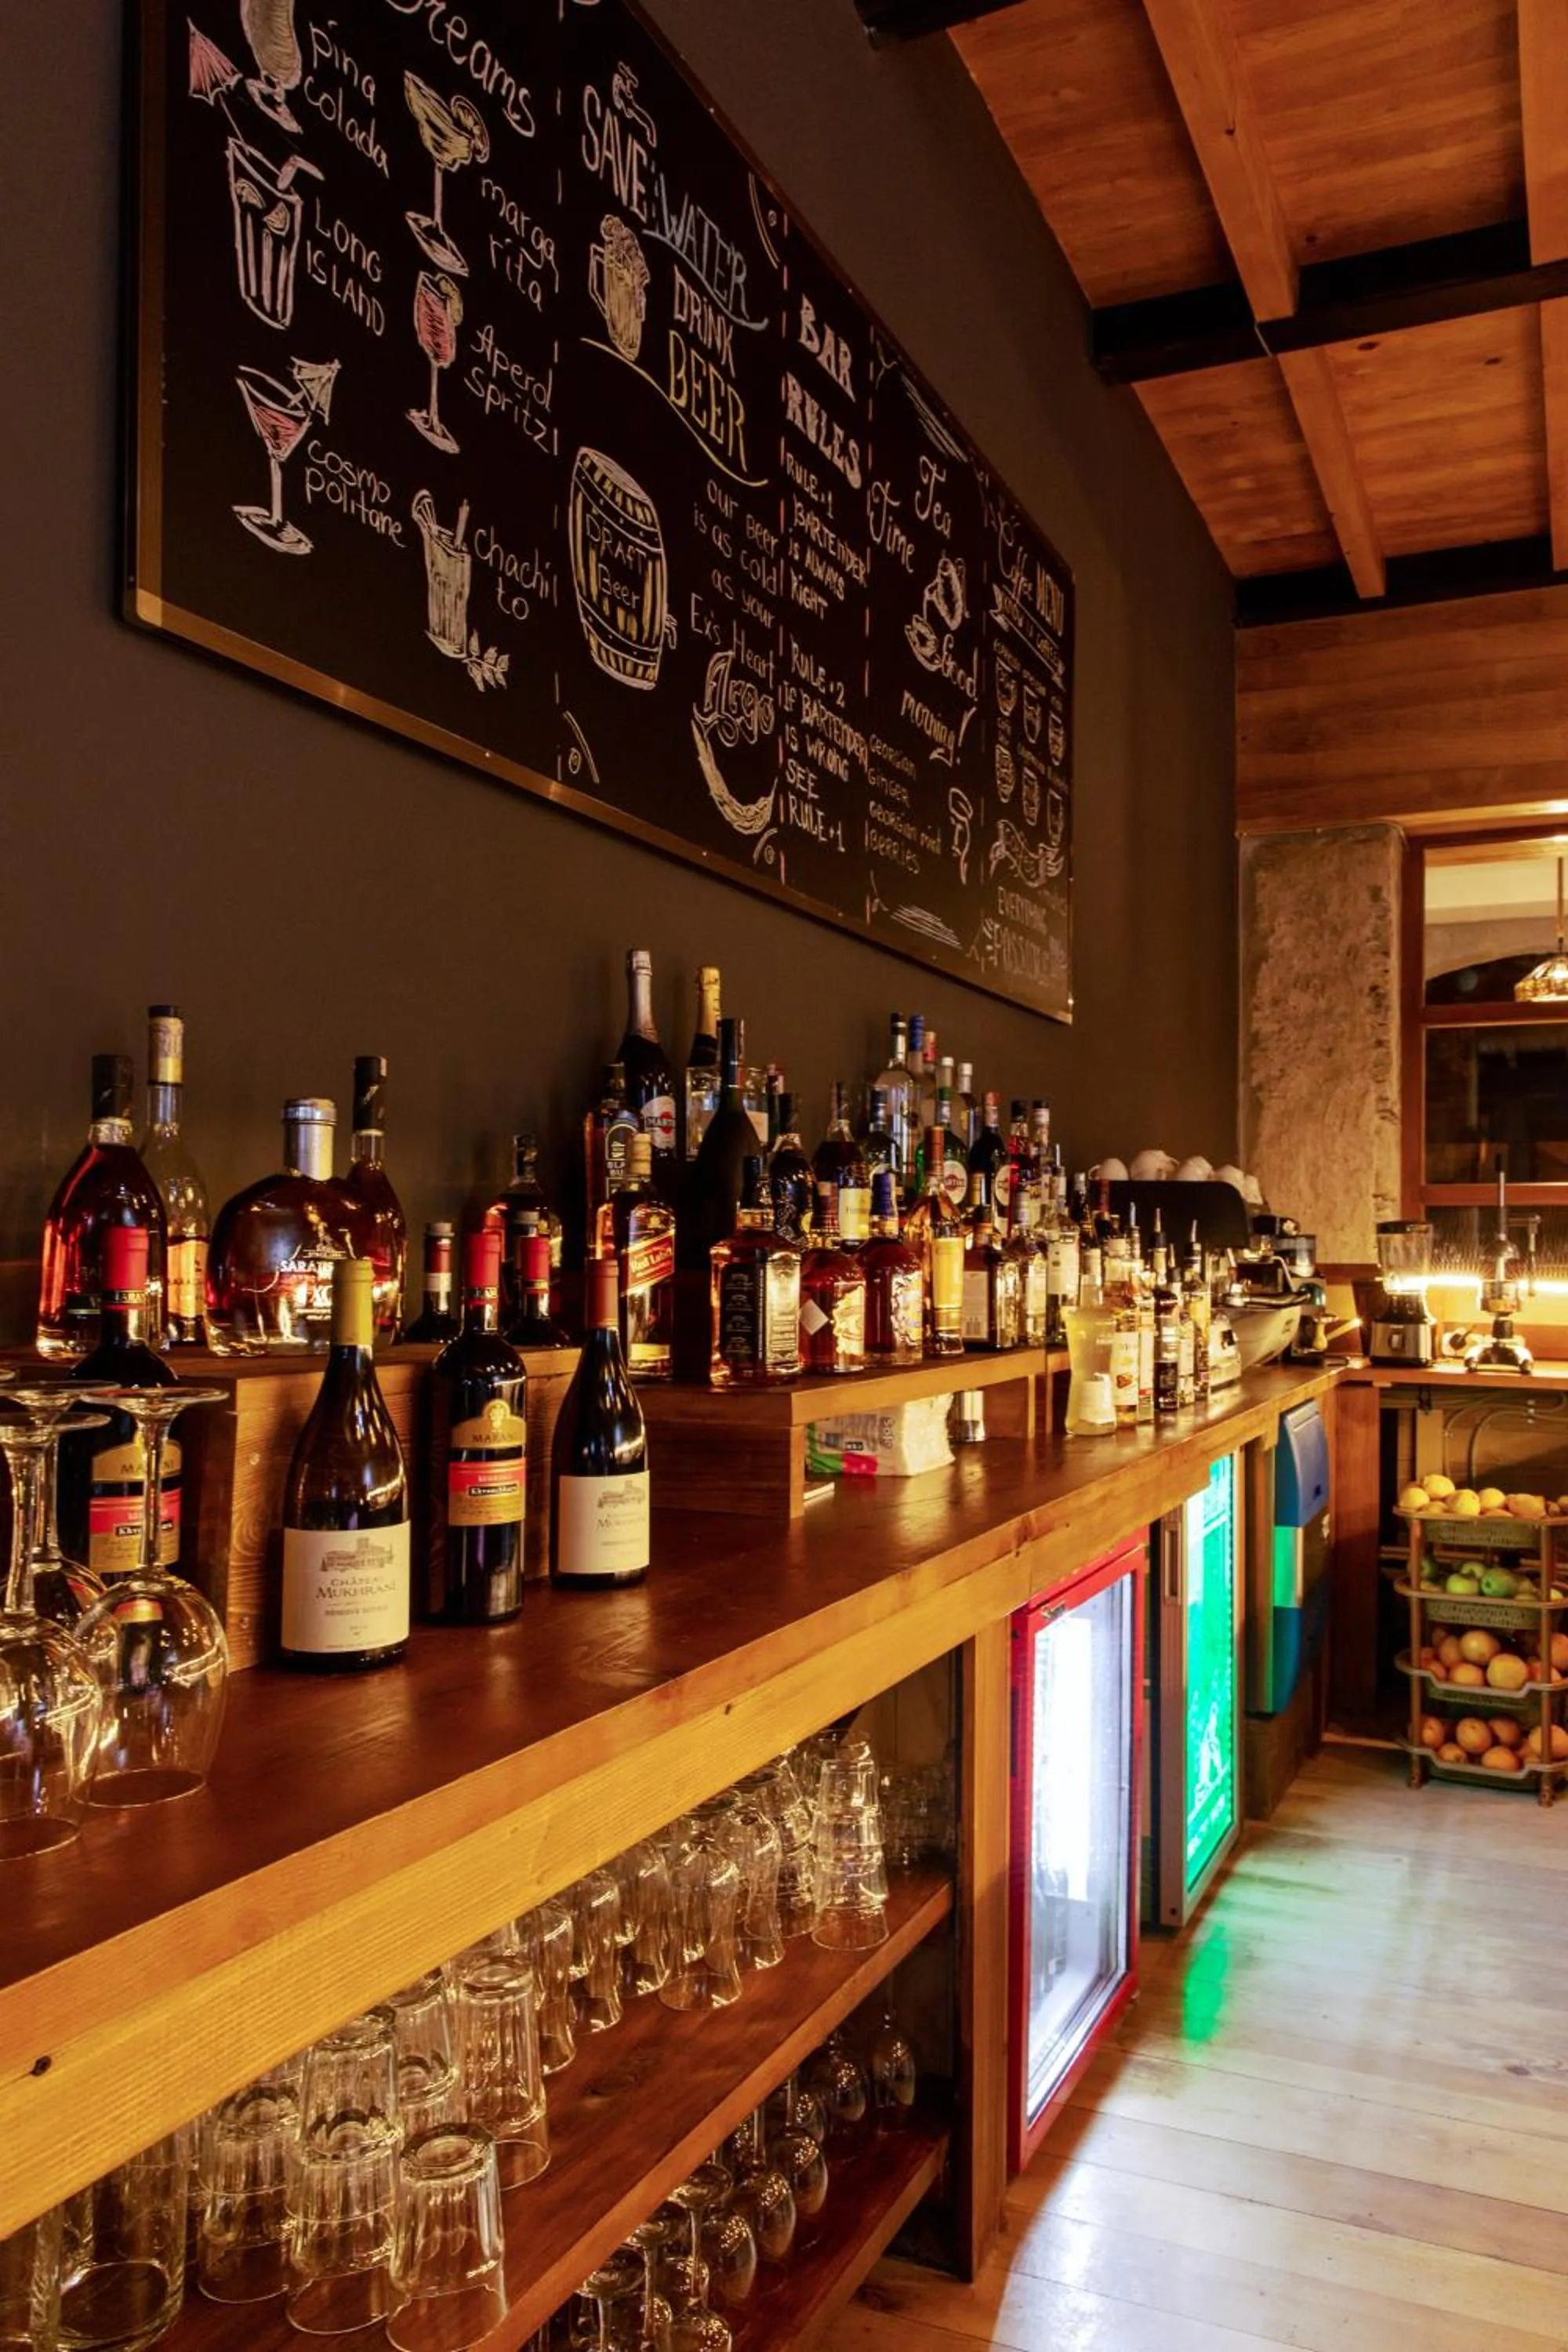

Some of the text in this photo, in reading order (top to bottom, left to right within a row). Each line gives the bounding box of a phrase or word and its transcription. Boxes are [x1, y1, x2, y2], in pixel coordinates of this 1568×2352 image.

[383, 0, 535, 137] reams
[304, 76, 390, 179] Colada
[582, 85, 750, 320] SAVE WATER
[799, 293, 856, 404] BAR
[669, 329, 747, 473] BEER
[786, 371, 862, 490] RULES
[786, 452, 818, 502] RULE
[915, 455, 953, 539] Tea
[694, 503, 706, 534] is
[712, 524, 734, 557] as
[869, 481, 916, 573] Time
[495, 576, 529, 620] to
[597, 563, 641, 612] Beer
[712, 568, 775, 630] as your
[732, 623, 775, 690] Heart
[790, 633, 826, 693] RULE
[786, 758, 820, 800] SEE
[788, 791, 829, 843] RULE
